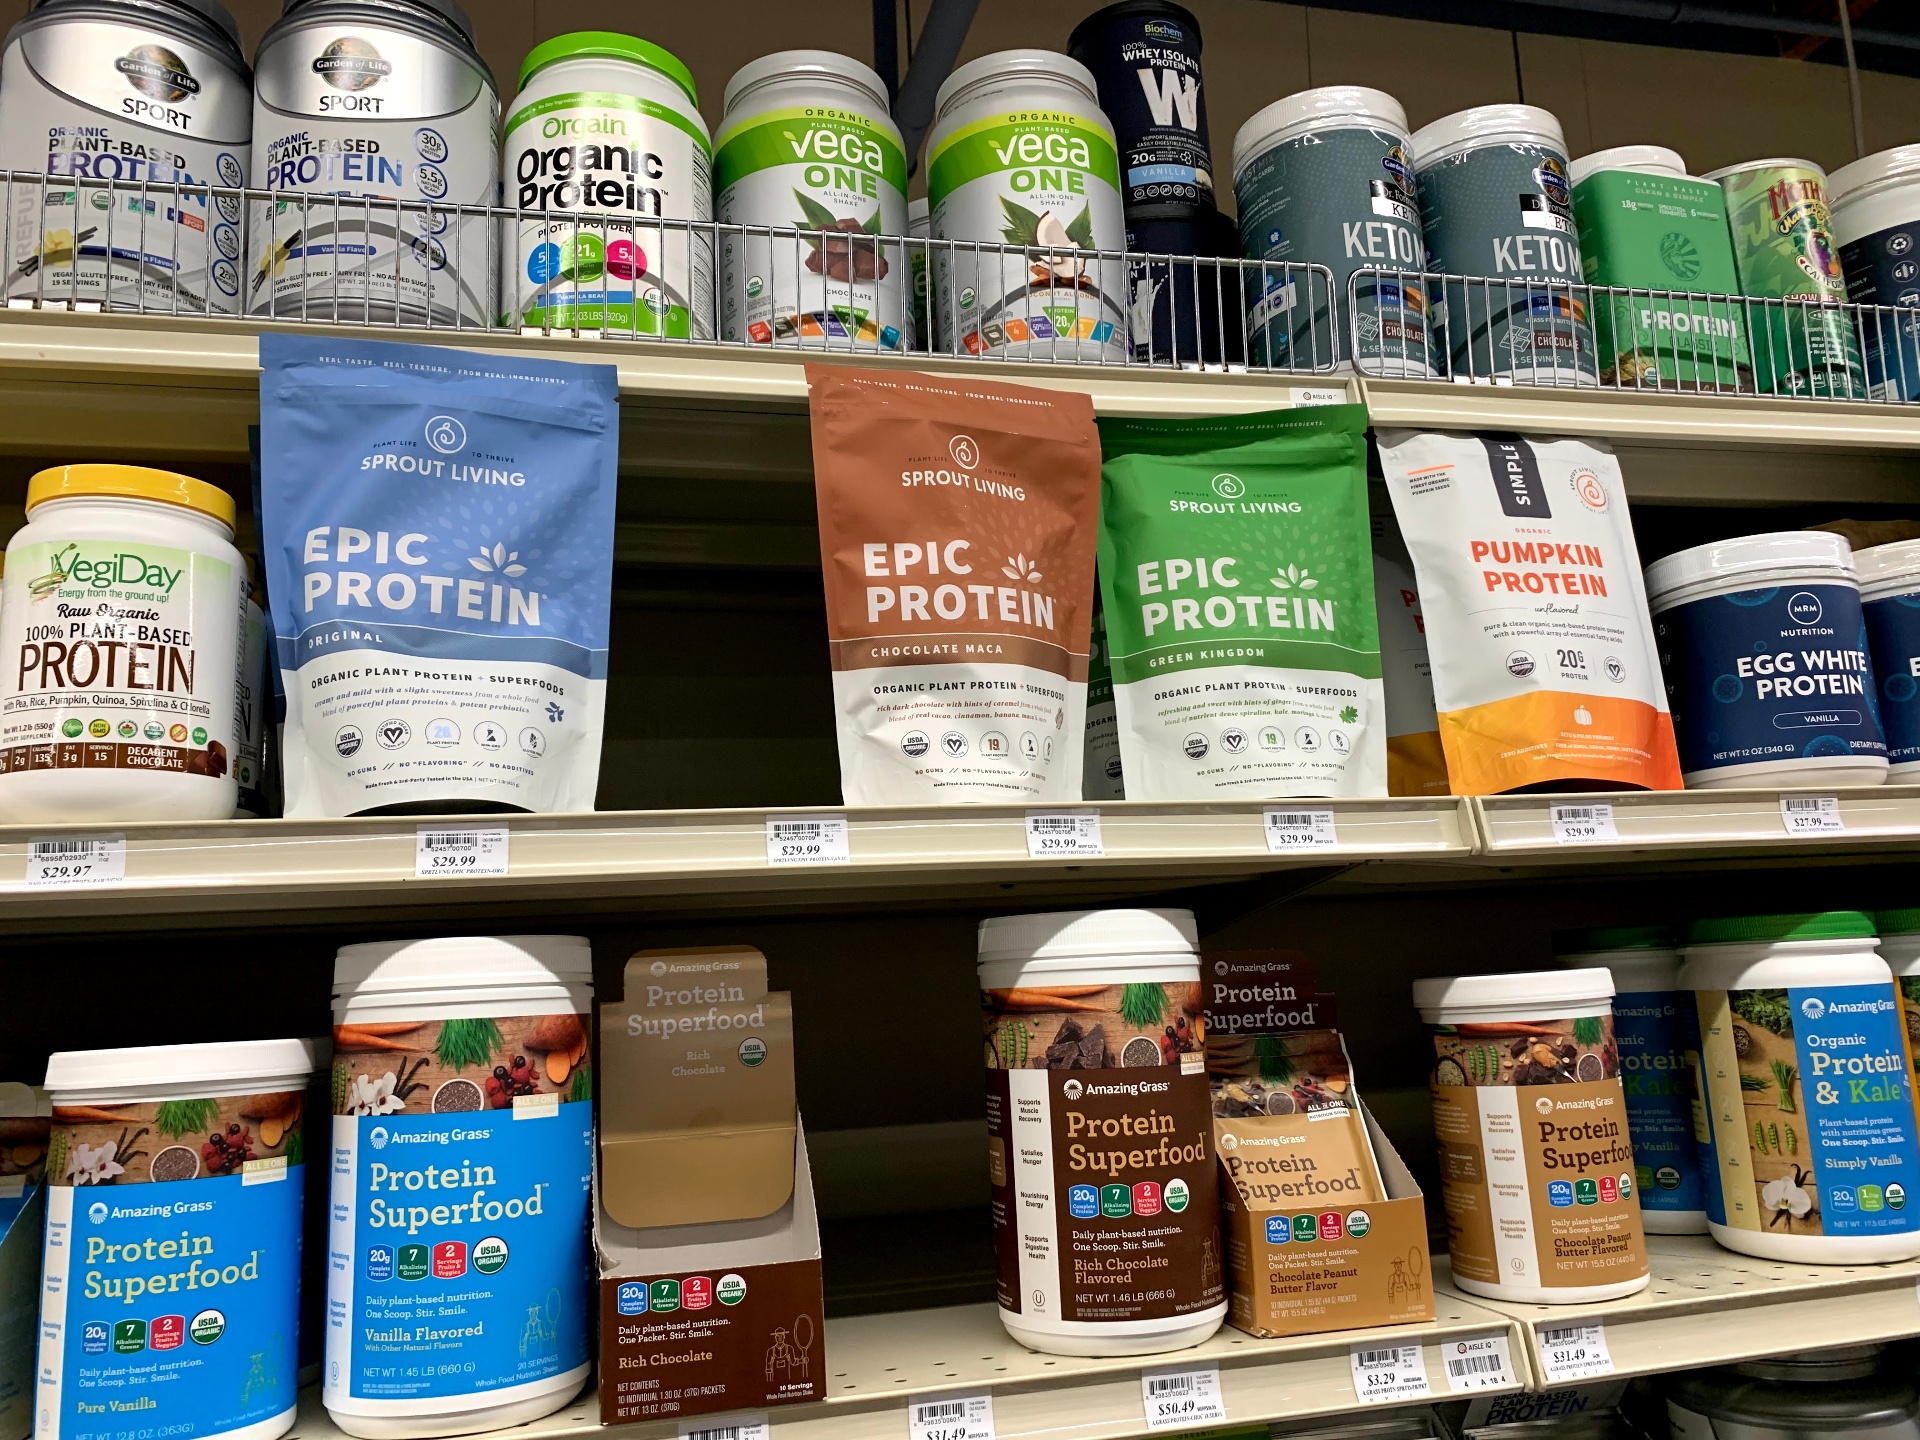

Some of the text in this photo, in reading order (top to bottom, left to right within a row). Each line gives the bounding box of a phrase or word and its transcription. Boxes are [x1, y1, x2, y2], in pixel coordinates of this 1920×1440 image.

[1144, 25, 1183, 38] Biochem
[1122, 42, 1146, 52] 100%
[316, 59, 390, 72] Garden of Life
[1123, 49, 1199, 74] WHEY ISOLATE
[1150, 58, 1185, 71] PROTEIN
[318, 95, 384, 114] SPORT
[121, 97, 192, 131] SPORT
[805, 109, 871, 128] ORGANIC
[1008, 113, 1075, 125] ORGANIC
[542, 113, 626, 140] Orgain
[267, 131, 309, 154] ORGANIC
[267, 139, 380, 168] PLANT-BASED
[517, 140, 663, 185] Organic
[267, 153, 403, 190] PROTEIN
[1142, 166, 1186, 177] VANILLA
[804, 165, 879, 199] ONE
[1010, 170, 1085, 194] ONE
[519, 174, 662, 222] Protein
[1030, 193, 1074, 201] ALL-IN-ONE
[1041, 199, 1066, 207] SHAKE
[360, 453, 526, 487] SPROUT LIVING
[1500, 444, 1531, 506] SIMPLE
[901, 469, 1026, 502] SPROUT LIVING
[1170, 500, 1302, 514] SPROUT LIVING
[303, 525, 429, 566] EPIC
[1470, 540, 1604, 568] PUMPKIN
[863, 539, 973, 577] EPIC
[54, 553, 185, 593] VegiDay
[1137, 556, 1240, 596] EPIC
[1482, 570, 1608, 598] PROTEIN
[58, 588, 169, 603] Energy from the ground up!
[304, 571, 541, 626] PROTEIN
[57, 603, 160, 621] Raw Organic
[866, 583, 1054, 631] PROTEIN
[1534, 603, 1579, 616] unflavored
[1794, 604, 1817, 613] MRM
[1142, 596, 1335, 637] PROTEIN
[25, 622, 191, 647] 100% PLANT-BASED
[308, 630, 383, 650] ORIGINAL
[1780, 628, 1834, 637] NUTRITION
[871, 643, 1003, 658] CHOCOLATE MACA
[1150, 648, 1264, 668] GREEN KINGDOM
[17, 642, 195, 695] PROTEIN
[1736, 650, 1868, 678] EGG WHITE
[312, 667, 565, 696] ORGANIC PLANT PROTEIN SUPERFOODS
[1756, 674, 1864, 700] PROTEIN
[15, 694, 127, 709] Pea, Rice, Pumpkin, Quinoa,
[1804, 714, 1840, 723] VANILLA
[127, 746, 178, 758] DECADENT
[1714, 744, 1794, 761] NET WT 12 OZ (340 G)
[127, 755, 183, 768] CHOCOLATE
[1794, 816, 1822, 828] $27.99
[1280, 834, 1314, 844] $29.99
[1565, 826, 1596, 838] $29.99
[781, 844, 820, 857] $29.99
[1041, 839, 1077, 849] $29.99
[432, 855, 477, 868] $29.99
[41, 865, 92, 879] $29.97
[669, 961, 740, 974] Amazing Grass
[646, 982, 744, 1007] Protein
[1213, 982, 1297, 1004] Protein
[1828, 1000, 1896, 1014] Amazing Grass
[627, 1004, 765, 1040] Superfood
[1806, 1034, 1866, 1049] Organic
[1810, 1049, 1902, 1076] Protein
[1086, 1081, 1168, 1096] Amazing Grass
[1816, 1076, 1900, 1105] & Kale
[1556, 1097, 1613, 1110] Amazing Grass
[1066, 1109, 1176, 1138] Protein
[1538, 1117, 1619, 1143] Protein
[391, 1128, 490, 1145] Amazing Grass
[1240, 1134, 1306, 1148] Amazing Grass
[1068, 1132, 1205, 1177] Superfood
[1825, 1154, 1903, 1170] Simply Vanilla
[1226, 1155, 1318, 1177] Protein
[370, 1160, 496, 1191] Protein
[1236, 1168, 1362, 1203] Superfood
[111, 1200, 213, 1219] Amazing Grass
[369, 1183, 543, 1235] Superfood
[85, 1231, 214, 1264] Protein
[1554, 1233, 1632, 1248] Chocolate Peanut
[1555, 1242, 1628, 1257] Butter Flavored
[1074, 1256, 1169, 1271] Rich Chocolate
[84, 1250, 259, 1304] Superfood
[1075, 1271, 1132, 1285] Flavored
[1270, 1267, 1357, 1283] Chocolate Peanut
[1270, 1280, 1338, 1295] Butter Flavor
[365, 1322, 483, 1342] Vanilla Flavored
[618, 1329, 714, 1345] One Packet. Stir. Smile.
[619, 1351, 713, 1369] Rich Chocolate
[1553, 1349, 1586, 1362] $31.49
[1367, 1373, 1396, 1388] $3.29
[77, 1397, 157, 1414] Pure Vanilla
[1158, 1401, 1196, 1416] $50.49
